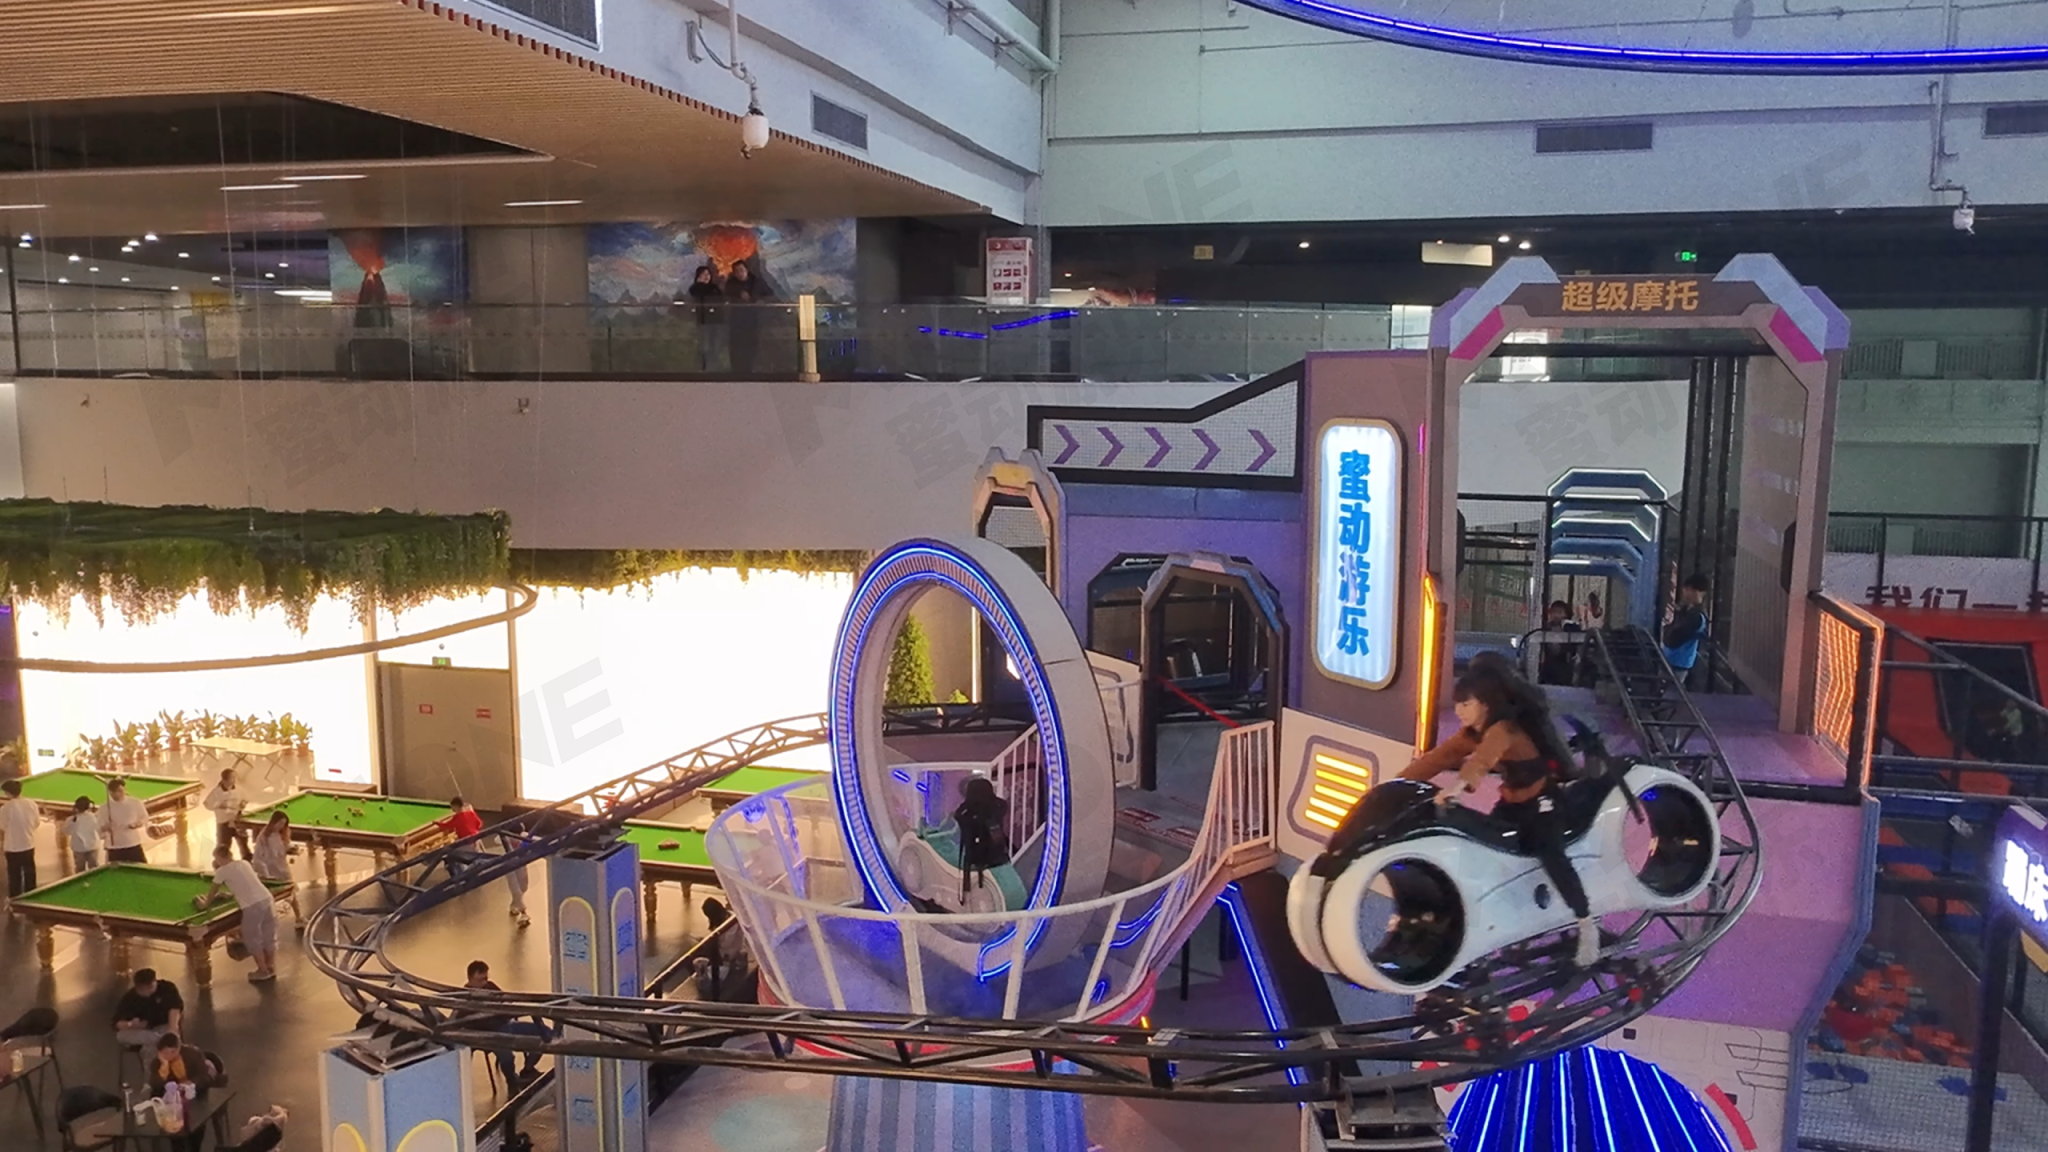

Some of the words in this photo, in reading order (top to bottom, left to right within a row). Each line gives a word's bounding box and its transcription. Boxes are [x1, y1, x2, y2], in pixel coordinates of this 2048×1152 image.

[1561, 279, 1700, 312] 超级摩托
[1337, 448, 1371, 657] 蜜动游乐
